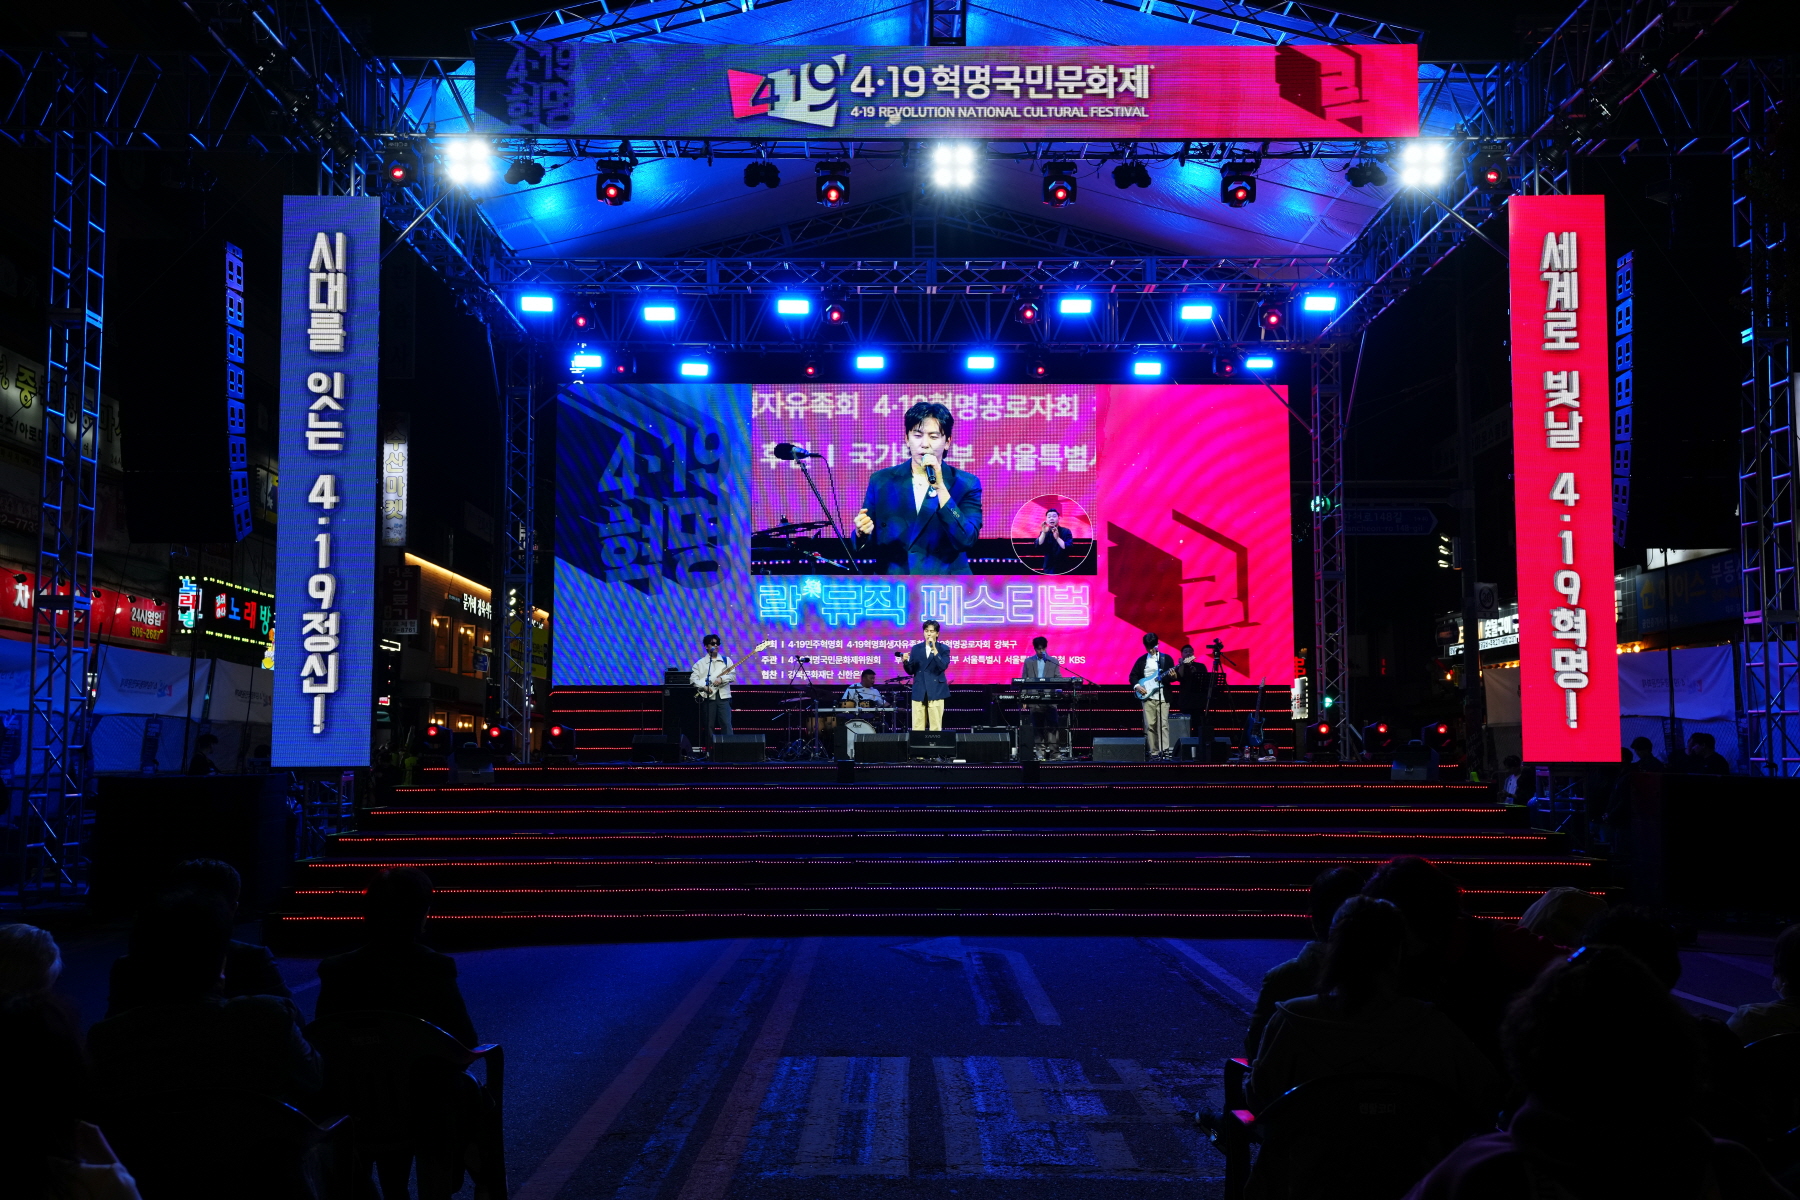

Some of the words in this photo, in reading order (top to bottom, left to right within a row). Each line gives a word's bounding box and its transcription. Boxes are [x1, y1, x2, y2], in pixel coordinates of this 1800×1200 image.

[878, 106, 955, 118] REVOLUTION
[957, 106, 1022, 118] NATIONAL
[1022, 106, 1088, 118] CULTURAL
[1090, 106, 1150, 118] FESTIVAL
[308, 231, 348, 352] 시대를
[1539, 231, 1580, 351] 세계로
[305, 371, 345, 451] 잇는
[752, 391, 858, 420] 자유족회
[872, 392, 1078, 422] 4·1명공로자회
[1543, 370, 1584, 449] 빛날
[851, 442, 976, 471] 국가부
[987, 442, 1096, 472] 서울특별
[131, 606, 162, 627] 24시영업
[228, 597, 272, 635] 노래방
[759, 584, 802, 626] 락
[821, 584, 906, 626] 뮤직
[920, 584, 1090, 626] 페스티벌
[761, 655, 778, 665] 주관
[962, 655, 1001, 665] 서울특별시
[1068, 655, 1086, 665] KBS
[993, 639, 1018, 650] 강북구
[761, 669, 778, 680] 협찬
[837, 669, 864, 680] 신한은
